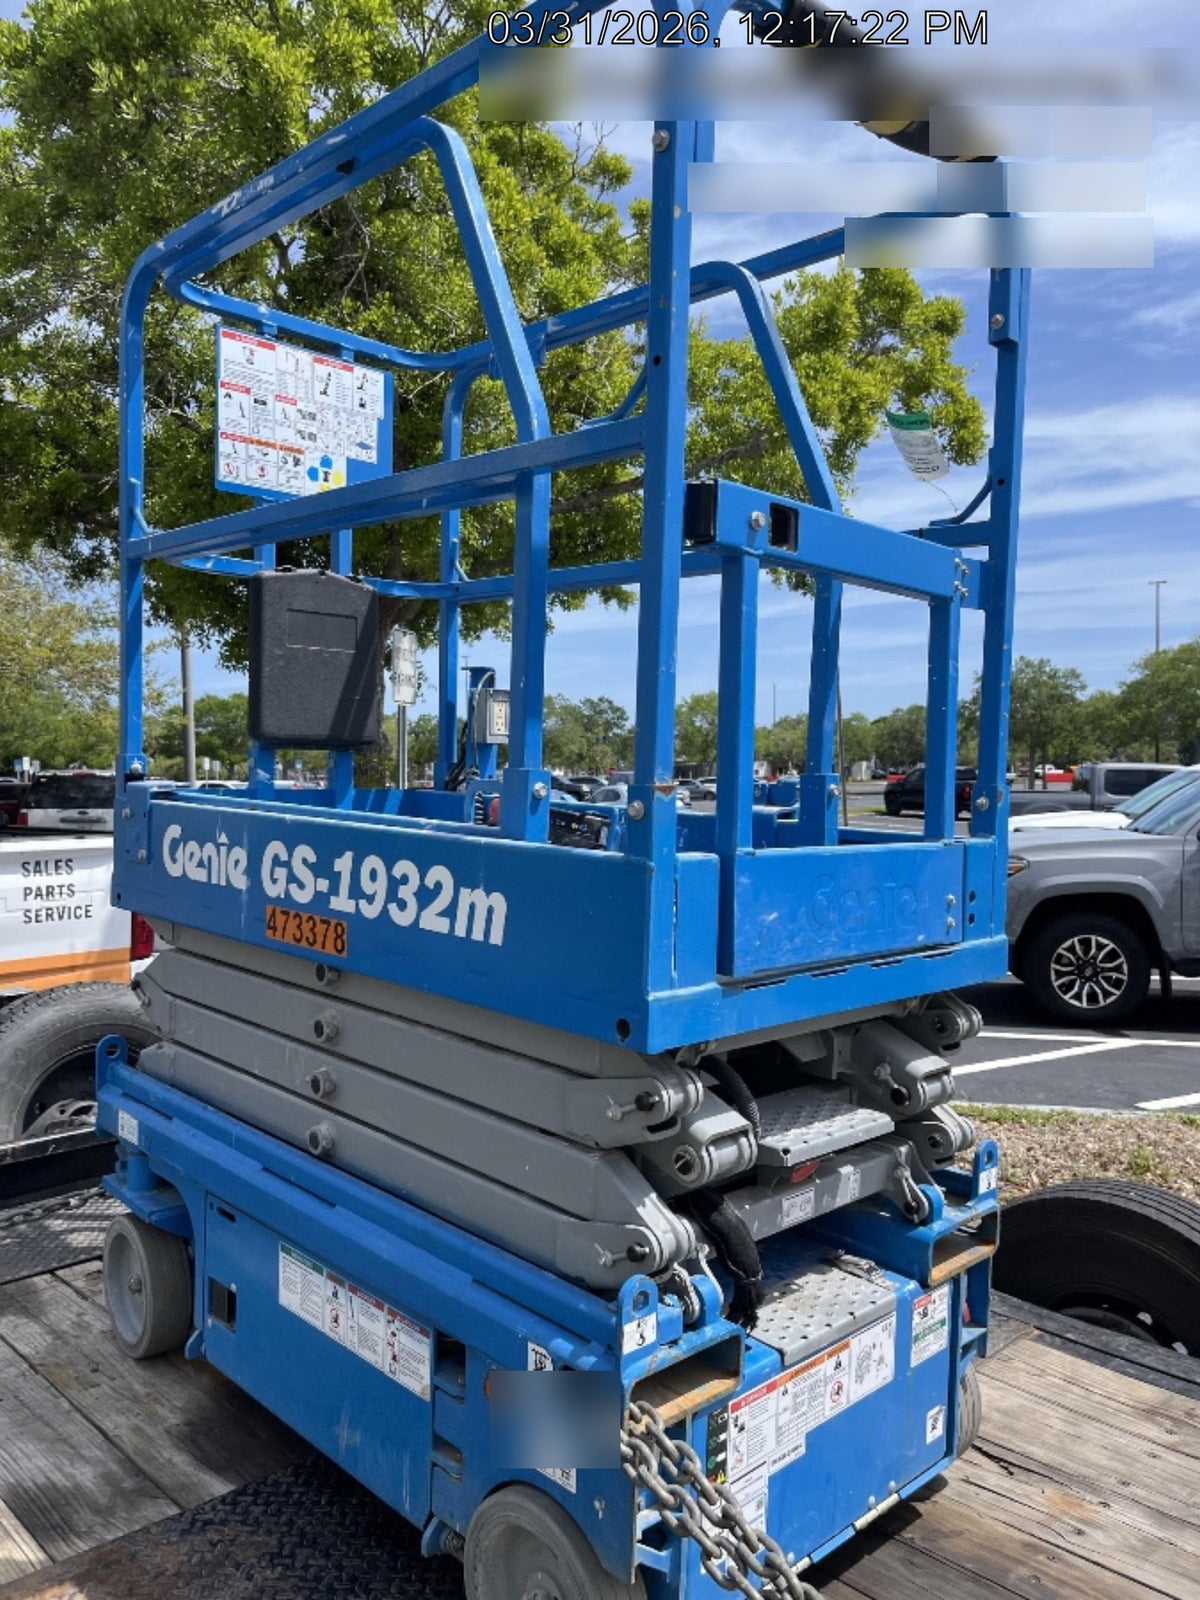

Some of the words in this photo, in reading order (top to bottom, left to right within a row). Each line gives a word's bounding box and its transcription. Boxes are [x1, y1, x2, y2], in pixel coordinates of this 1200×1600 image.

[21, 858, 74, 877] SALES
[23, 883, 76, 902] PARTS
[162, 824, 248, 891] Genie
[261, 840, 507, 946] GS-1932m
[23, 904, 93, 924] SERVICE
[266, 908, 347, 956] 473378
